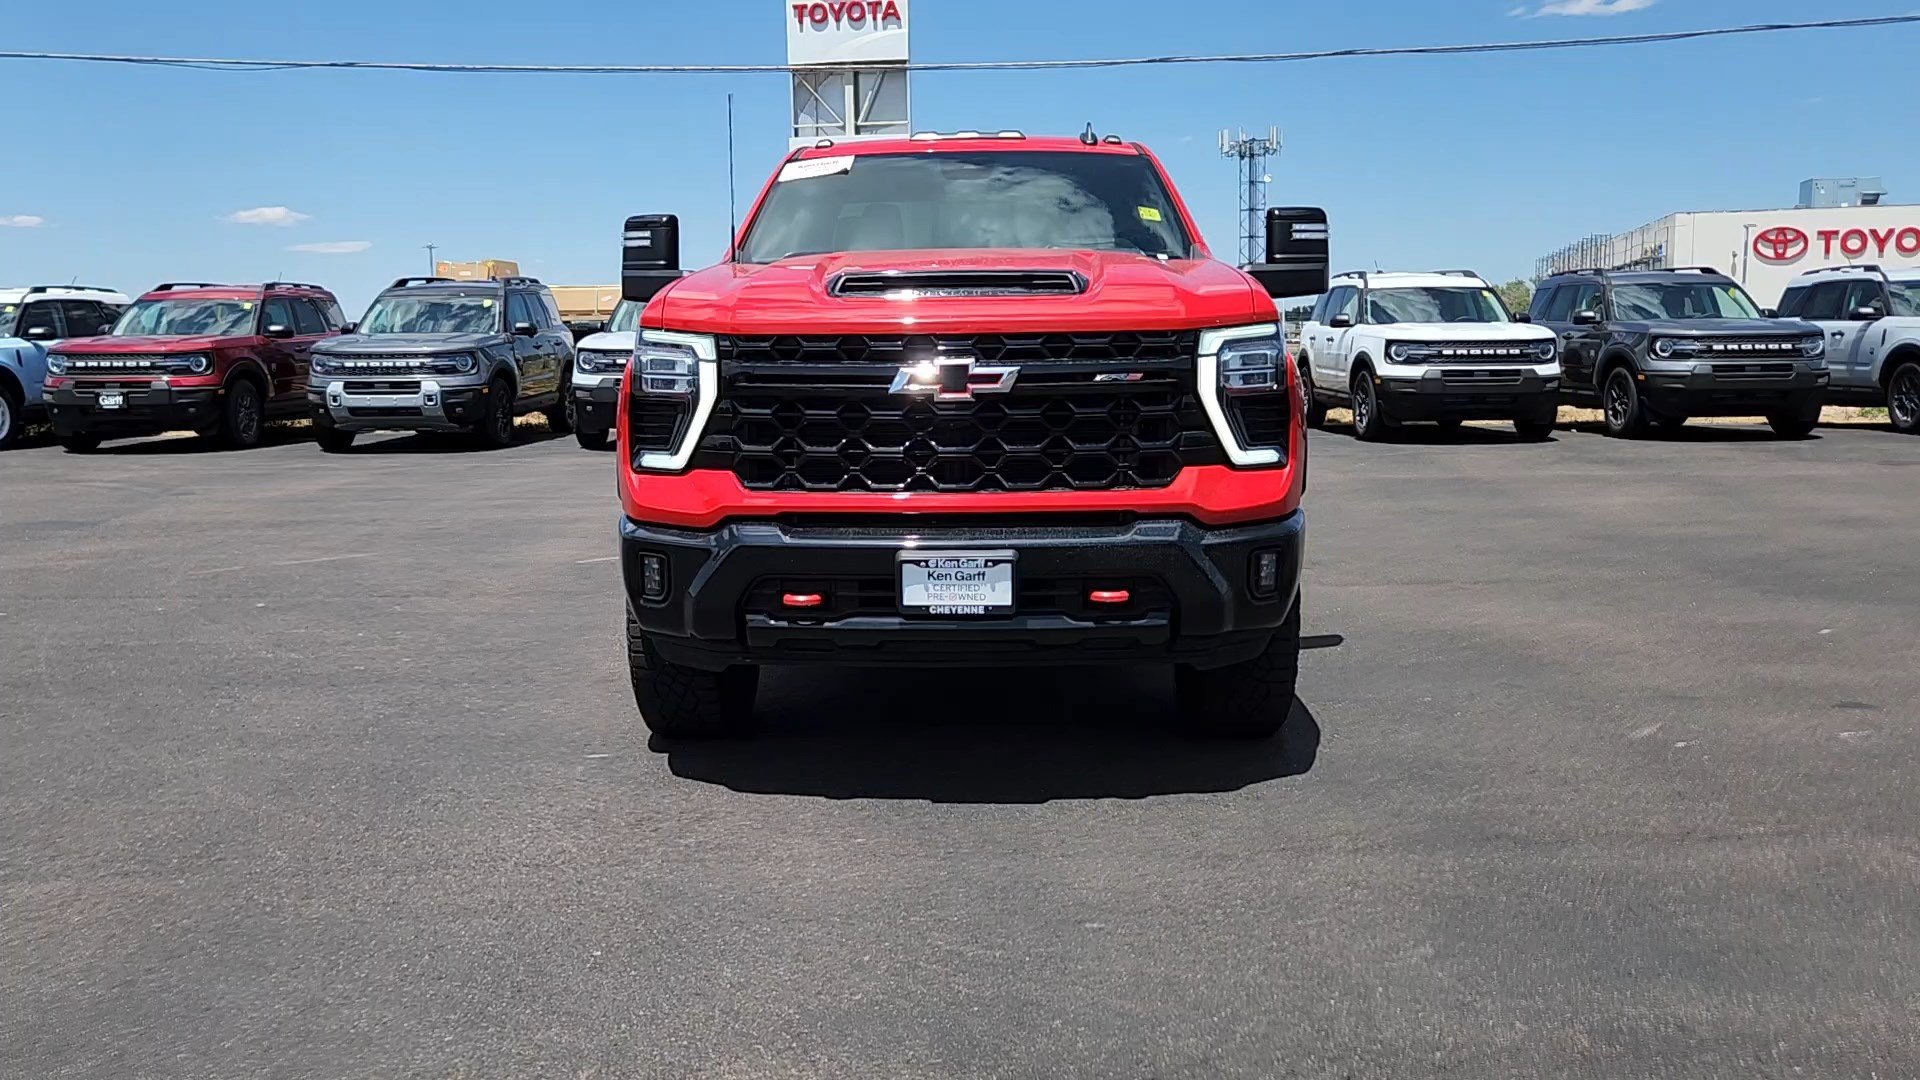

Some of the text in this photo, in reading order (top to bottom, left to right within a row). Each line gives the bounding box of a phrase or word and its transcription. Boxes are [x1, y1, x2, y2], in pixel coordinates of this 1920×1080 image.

[792, 0, 902, 24] TOYOTA
[1817, 227, 1920, 255] TOYO
[99, 395, 123, 405] Garff
[938, 559, 985, 568] Ken Garff
[927, 570, 986, 581] Ken Garff
[929, 606, 985, 614] CHEYENNE
